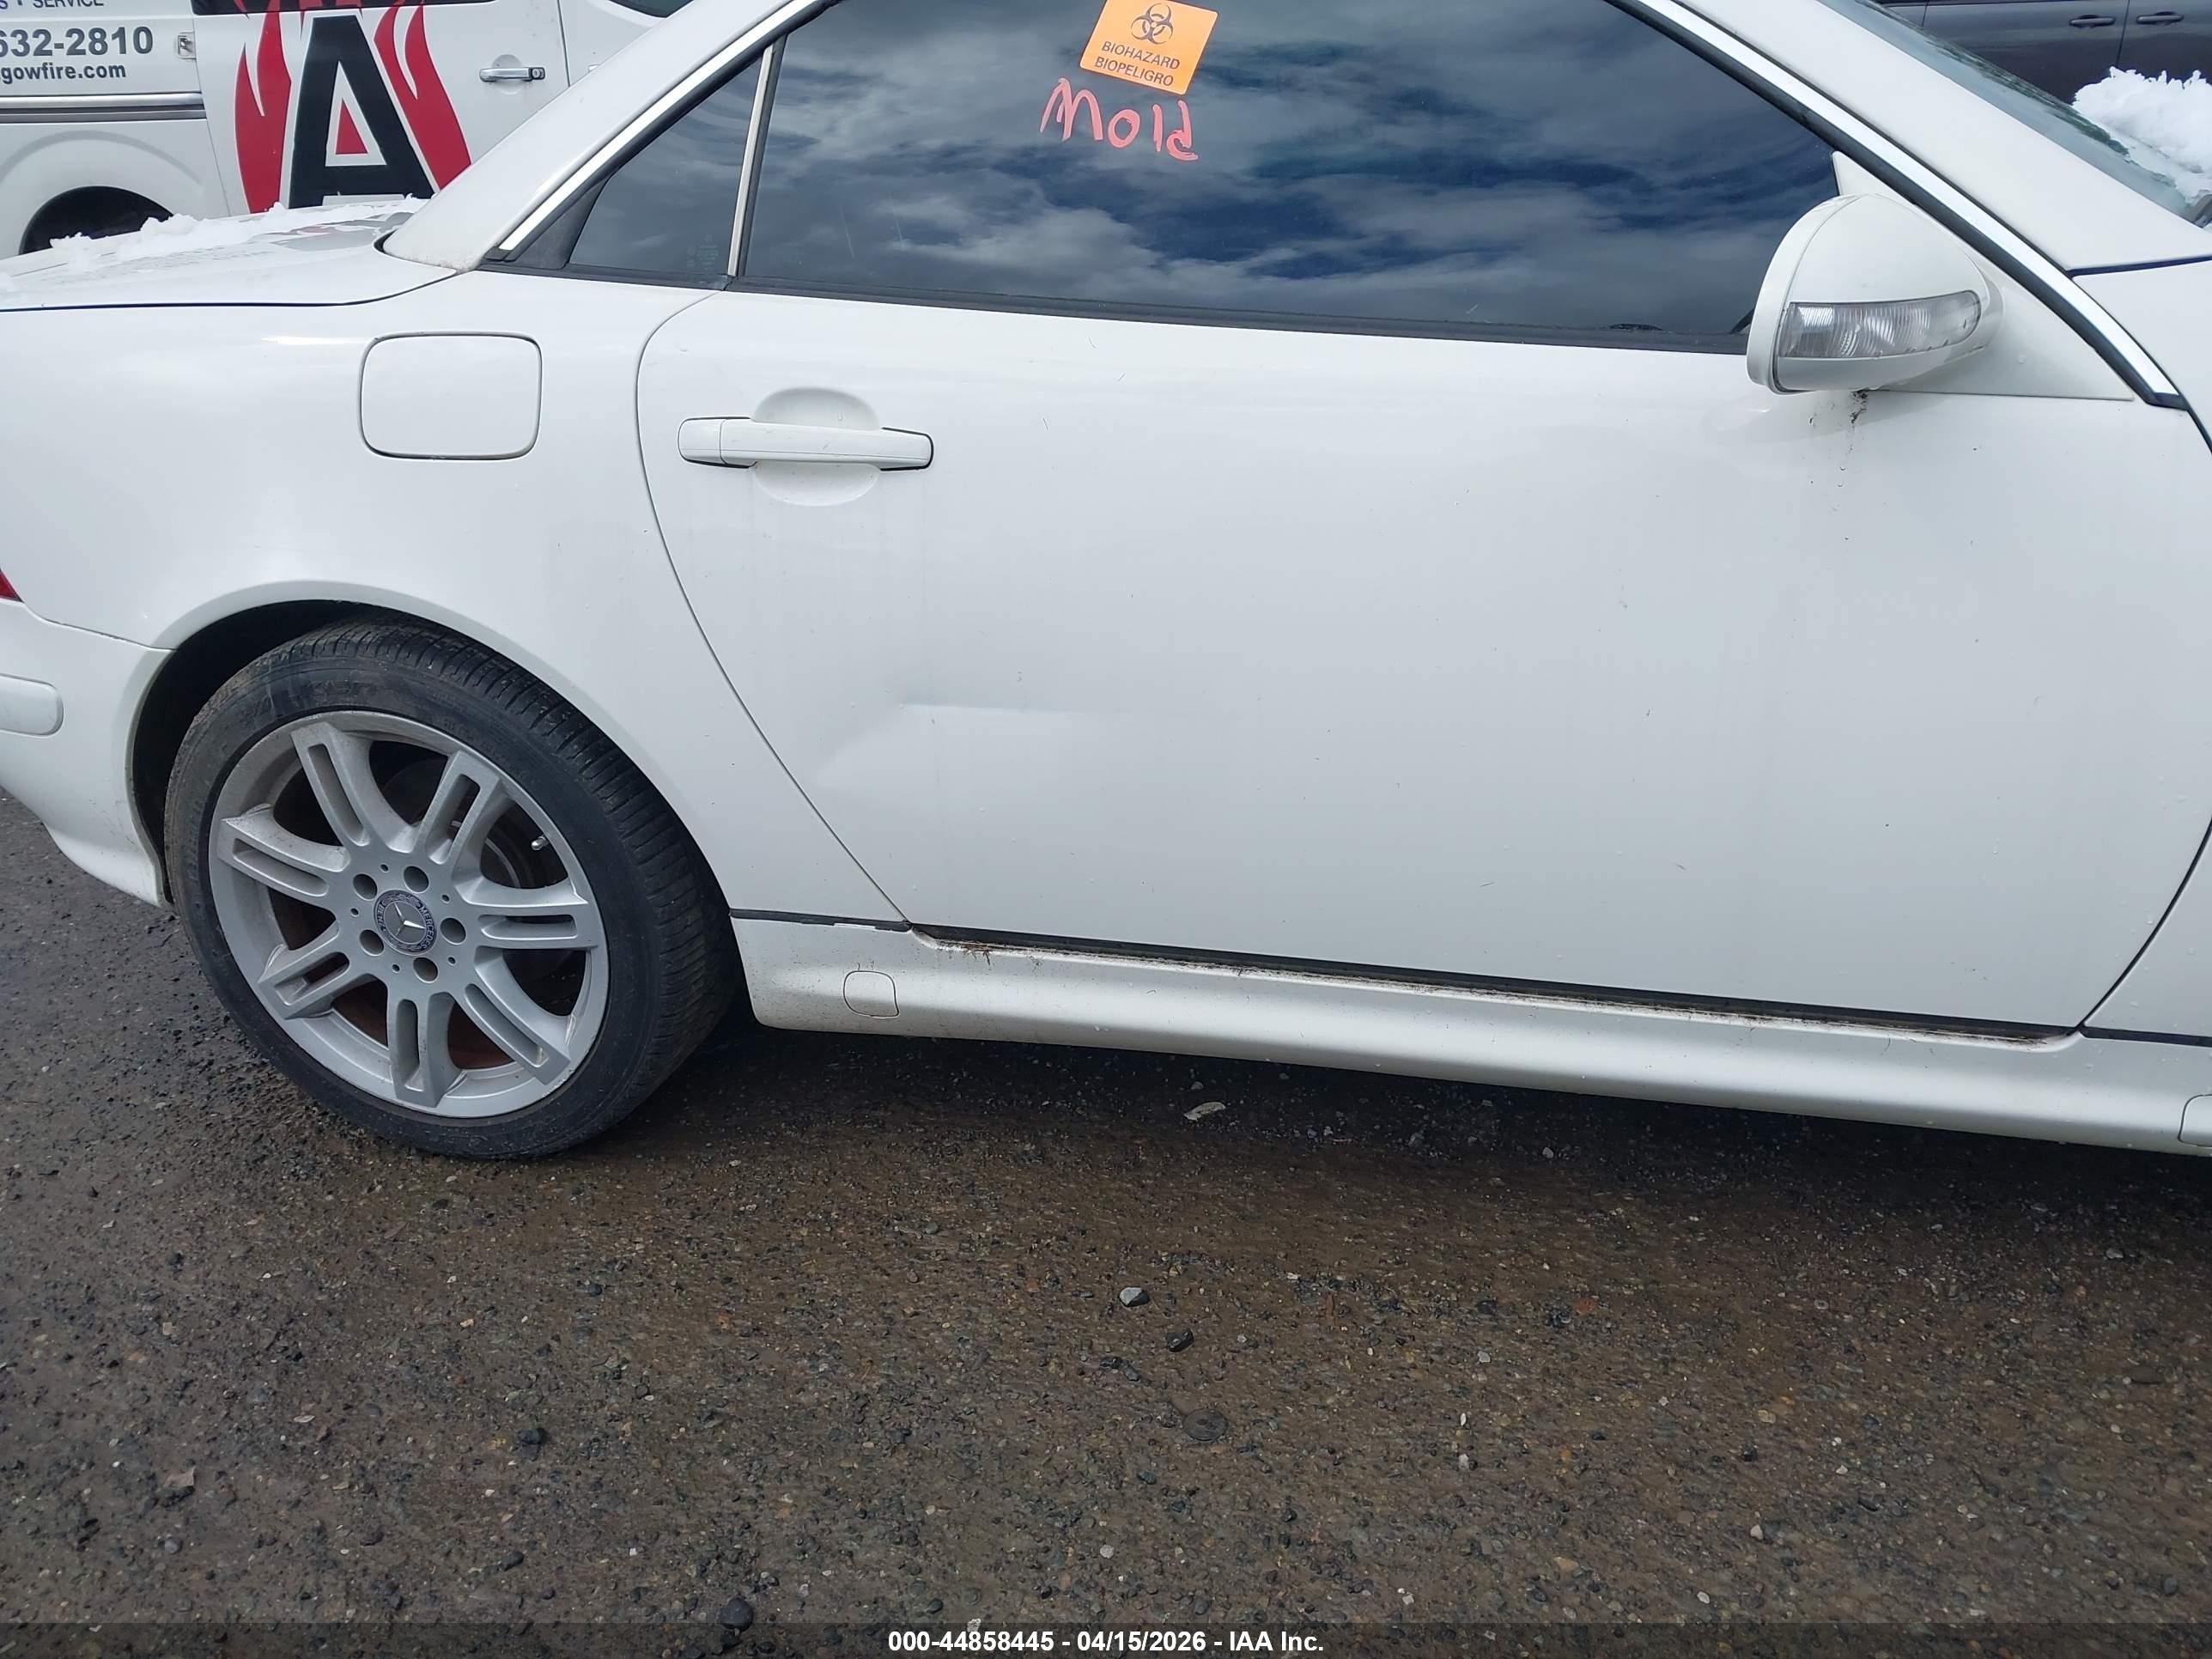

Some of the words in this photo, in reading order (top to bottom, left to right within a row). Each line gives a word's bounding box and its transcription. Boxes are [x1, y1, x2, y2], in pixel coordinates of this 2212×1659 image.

[1101, 41, 1181, 70] BIOHAZARD
[0, 62, 126, 84] gowfire.com
[1095, 57, 1174, 87] BIOPELIGRO
[1039, 77, 1199, 161] Mold
